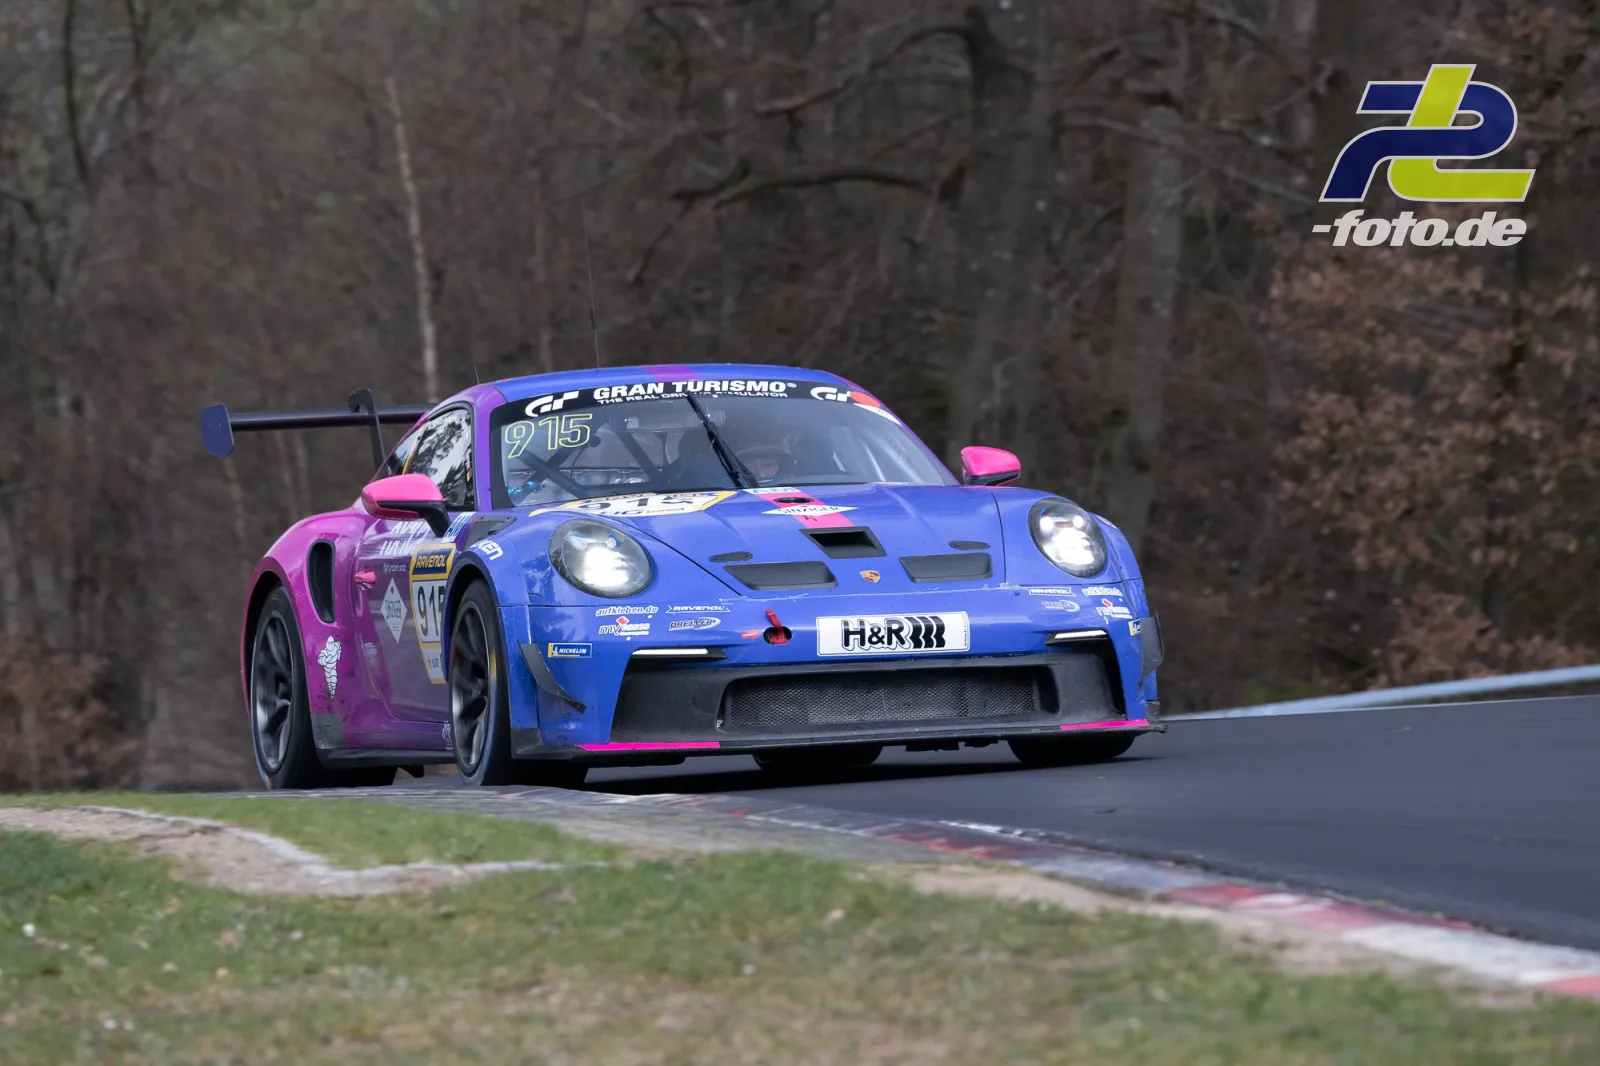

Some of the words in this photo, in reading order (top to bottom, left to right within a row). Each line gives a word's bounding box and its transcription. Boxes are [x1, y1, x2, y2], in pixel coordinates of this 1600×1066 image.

[593, 382, 664, 400] GRAN
[505, 413, 593, 459] 915
[415, 554, 447, 569] RAVENOL
[595, 605, 659, 617] aufkleben.de
[842, 619, 909, 650] H&R
